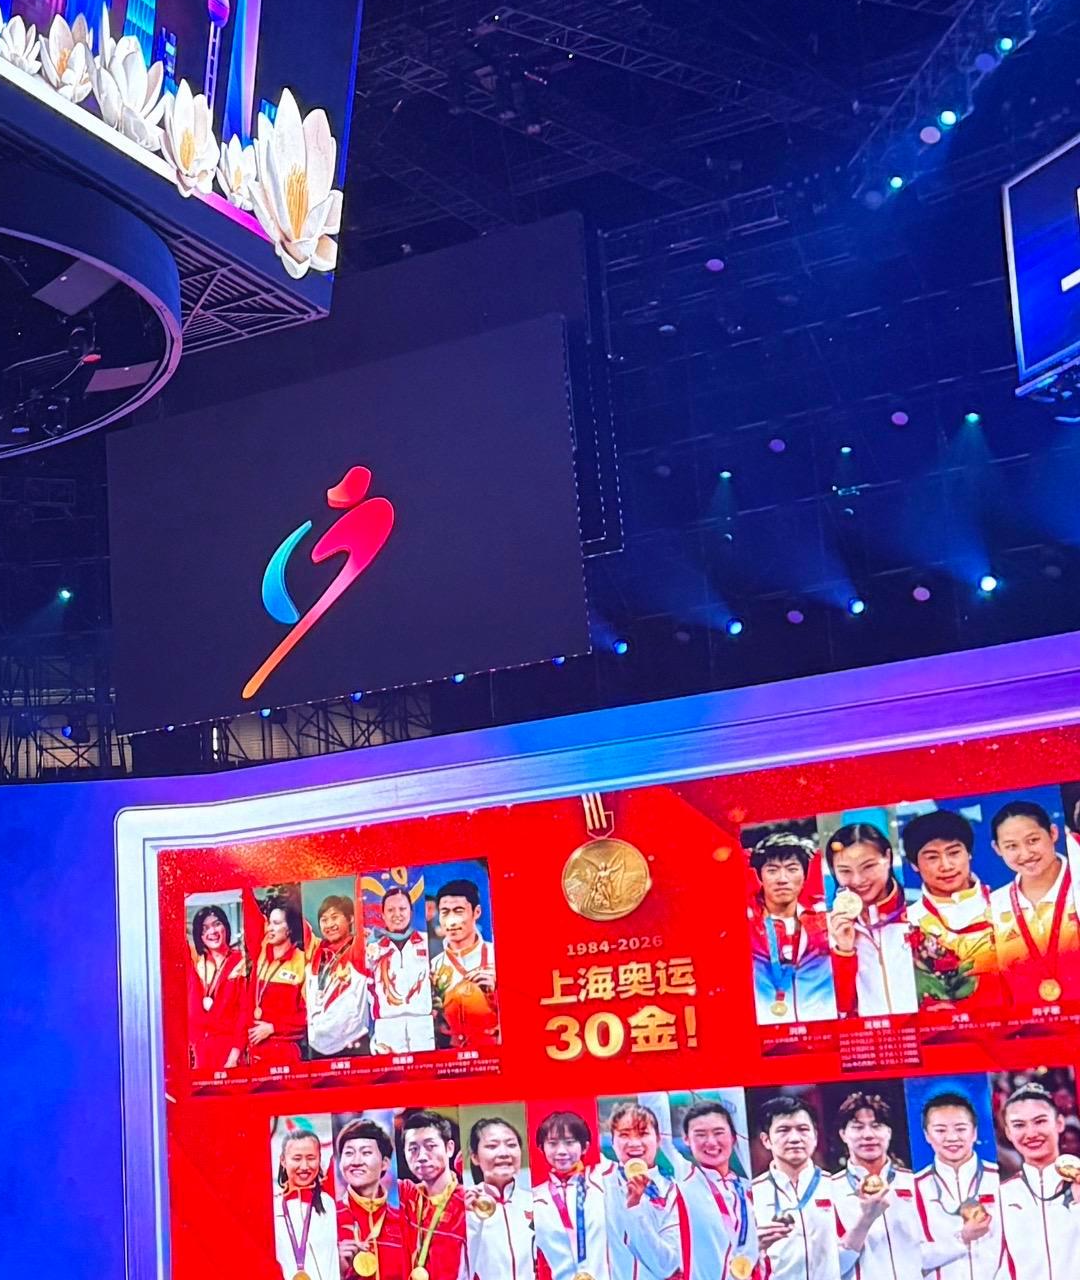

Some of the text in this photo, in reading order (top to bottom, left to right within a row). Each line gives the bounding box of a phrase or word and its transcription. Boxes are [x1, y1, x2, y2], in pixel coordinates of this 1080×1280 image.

[567, 935, 663, 956] 1984-2026
[540, 957, 697, 1005] 上海奥运
